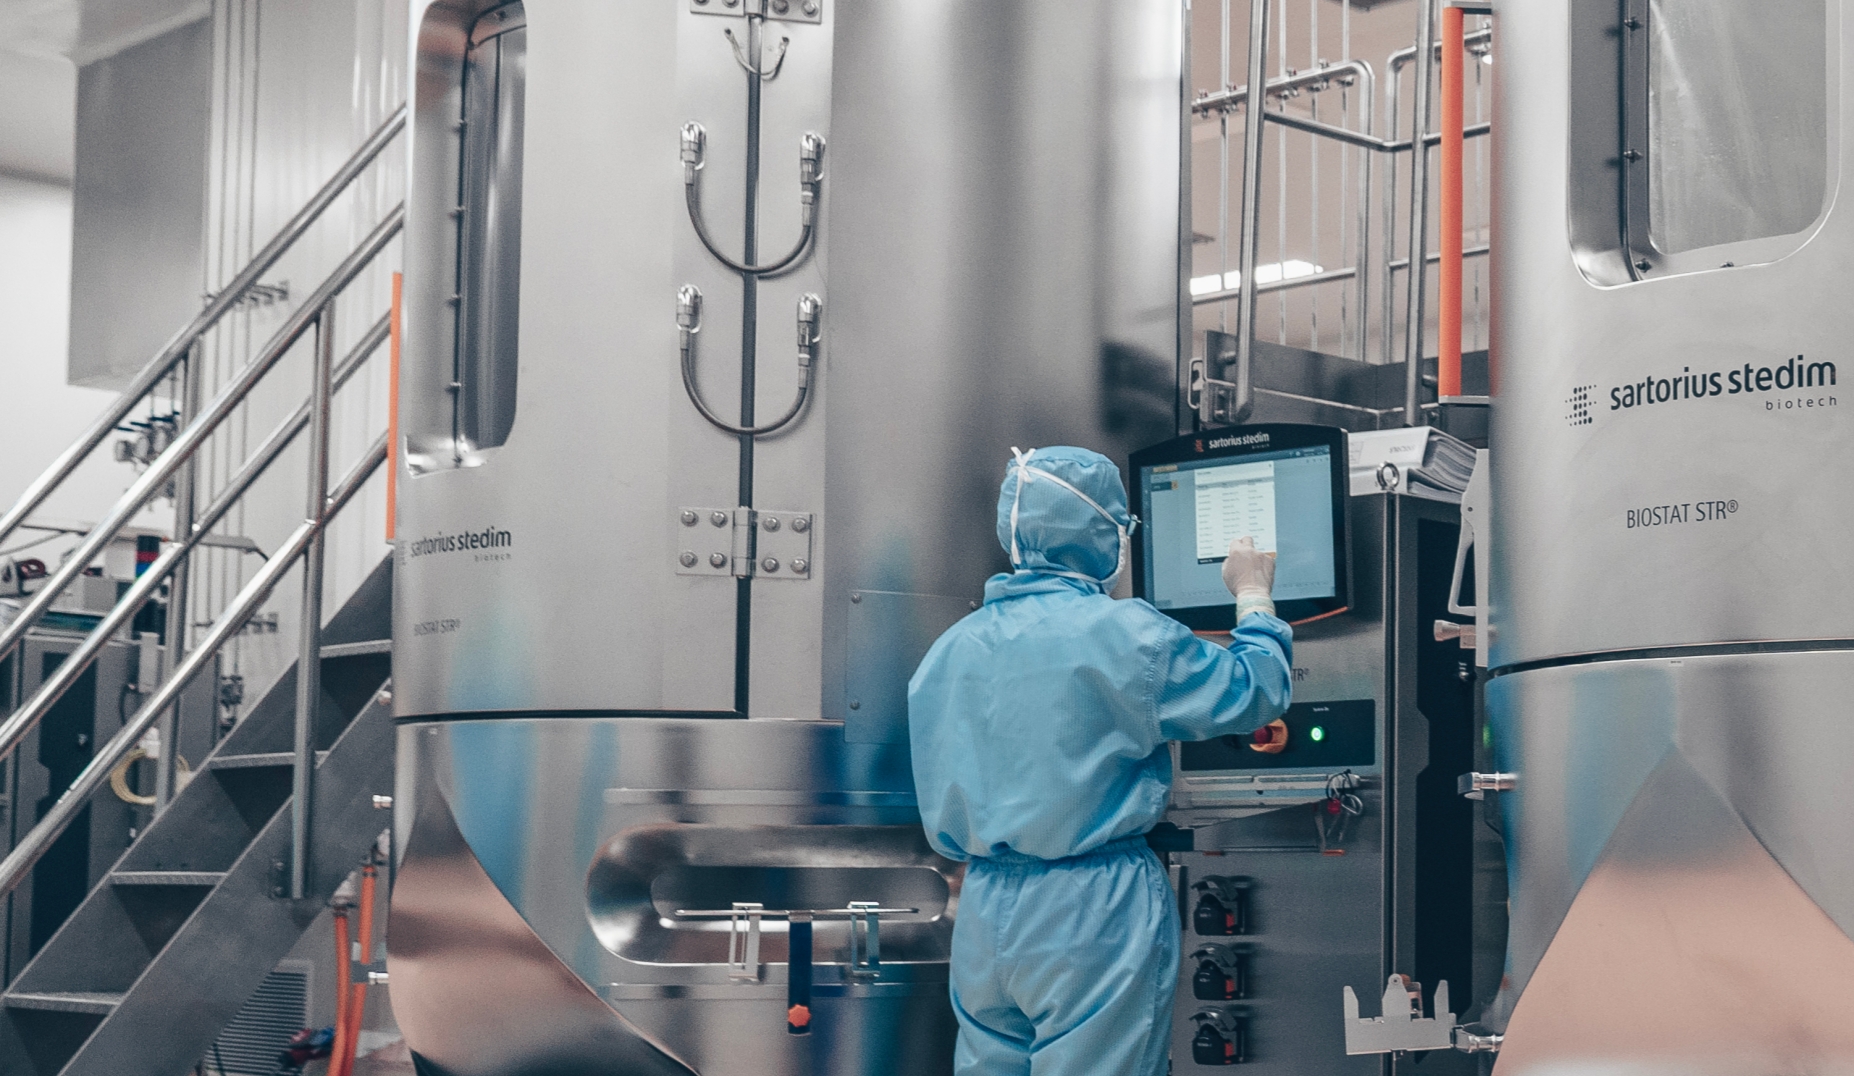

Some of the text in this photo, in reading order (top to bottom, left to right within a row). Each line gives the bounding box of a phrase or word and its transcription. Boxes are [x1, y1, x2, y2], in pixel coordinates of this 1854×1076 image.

[1610, 354, 1837, 411] sartorius stedim
[1765, 395, 1837, 411] biotech
[1208, 434, 1242, 450] sartorius
[1242, 431, 1270, 445] stedim
[1626, 502, 1691, 529] BIOSTAT
[411, 525, 512, 558] sartorius stedim
